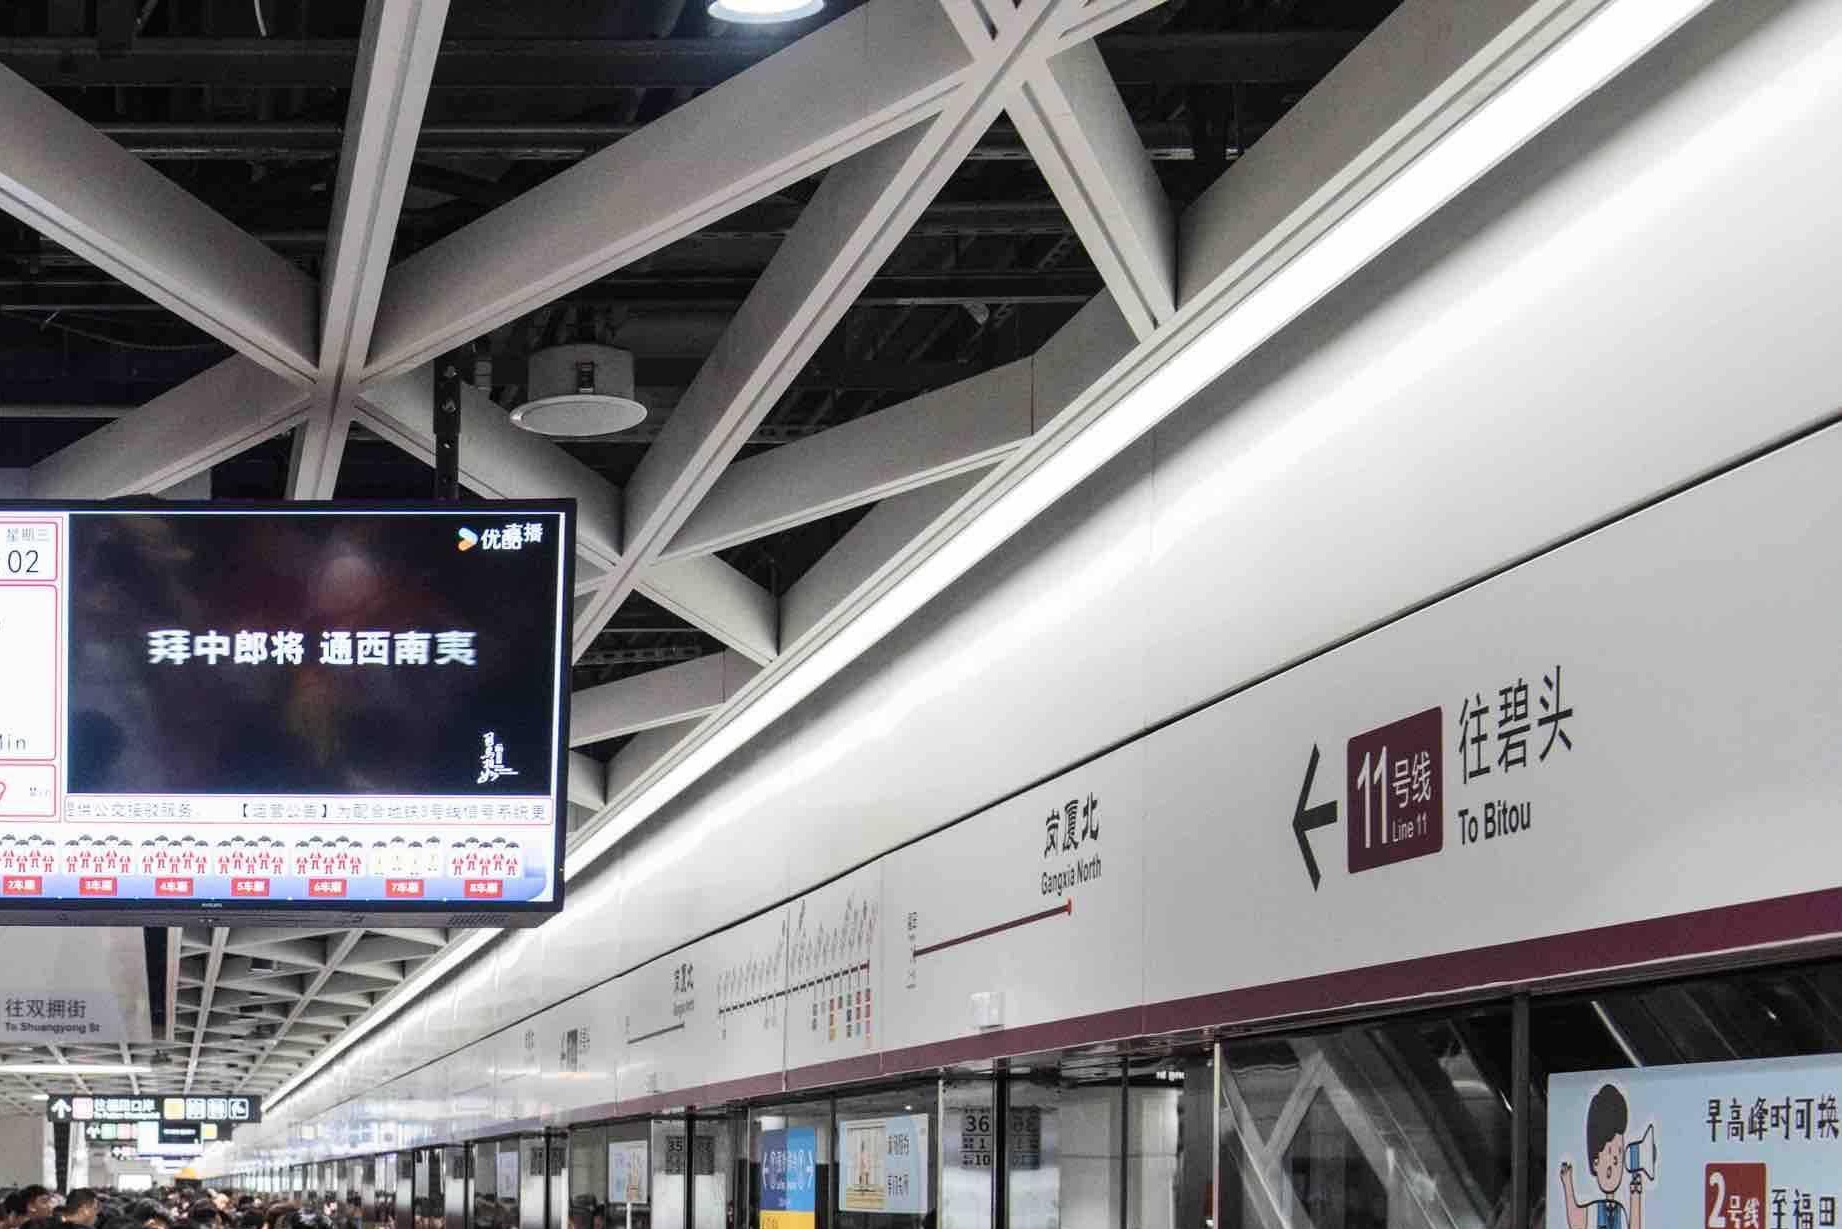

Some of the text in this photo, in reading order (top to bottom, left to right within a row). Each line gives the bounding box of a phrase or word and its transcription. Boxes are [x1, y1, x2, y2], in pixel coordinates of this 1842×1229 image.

[147, 630, 478, 665] 拜中郎将 通西南夷
[1459, 665, 1574, 785] 往碧头
[1357, 745, 1432, 849] 11号线
[1043, 791, 1100, 859] 岗厦北
[1391, 811, 1429, 843] Line 11
[1458, 799, 1532, 845] To Bitou
[1041, 853, 1102, 897] Gangxia North
[4, 998, 87, 1019] 往双拥街
[5, 1021, 18, 1032] To
[20, 1021, 87, 1035] Shuangyong
[965, 1115, 990, 1133] 36
[1705, 1092, 1840, 1143] 早高峰时可换
[974, 1154, 991, 1166] 10
[1709, 1171, 1760, 1229] 2号线
